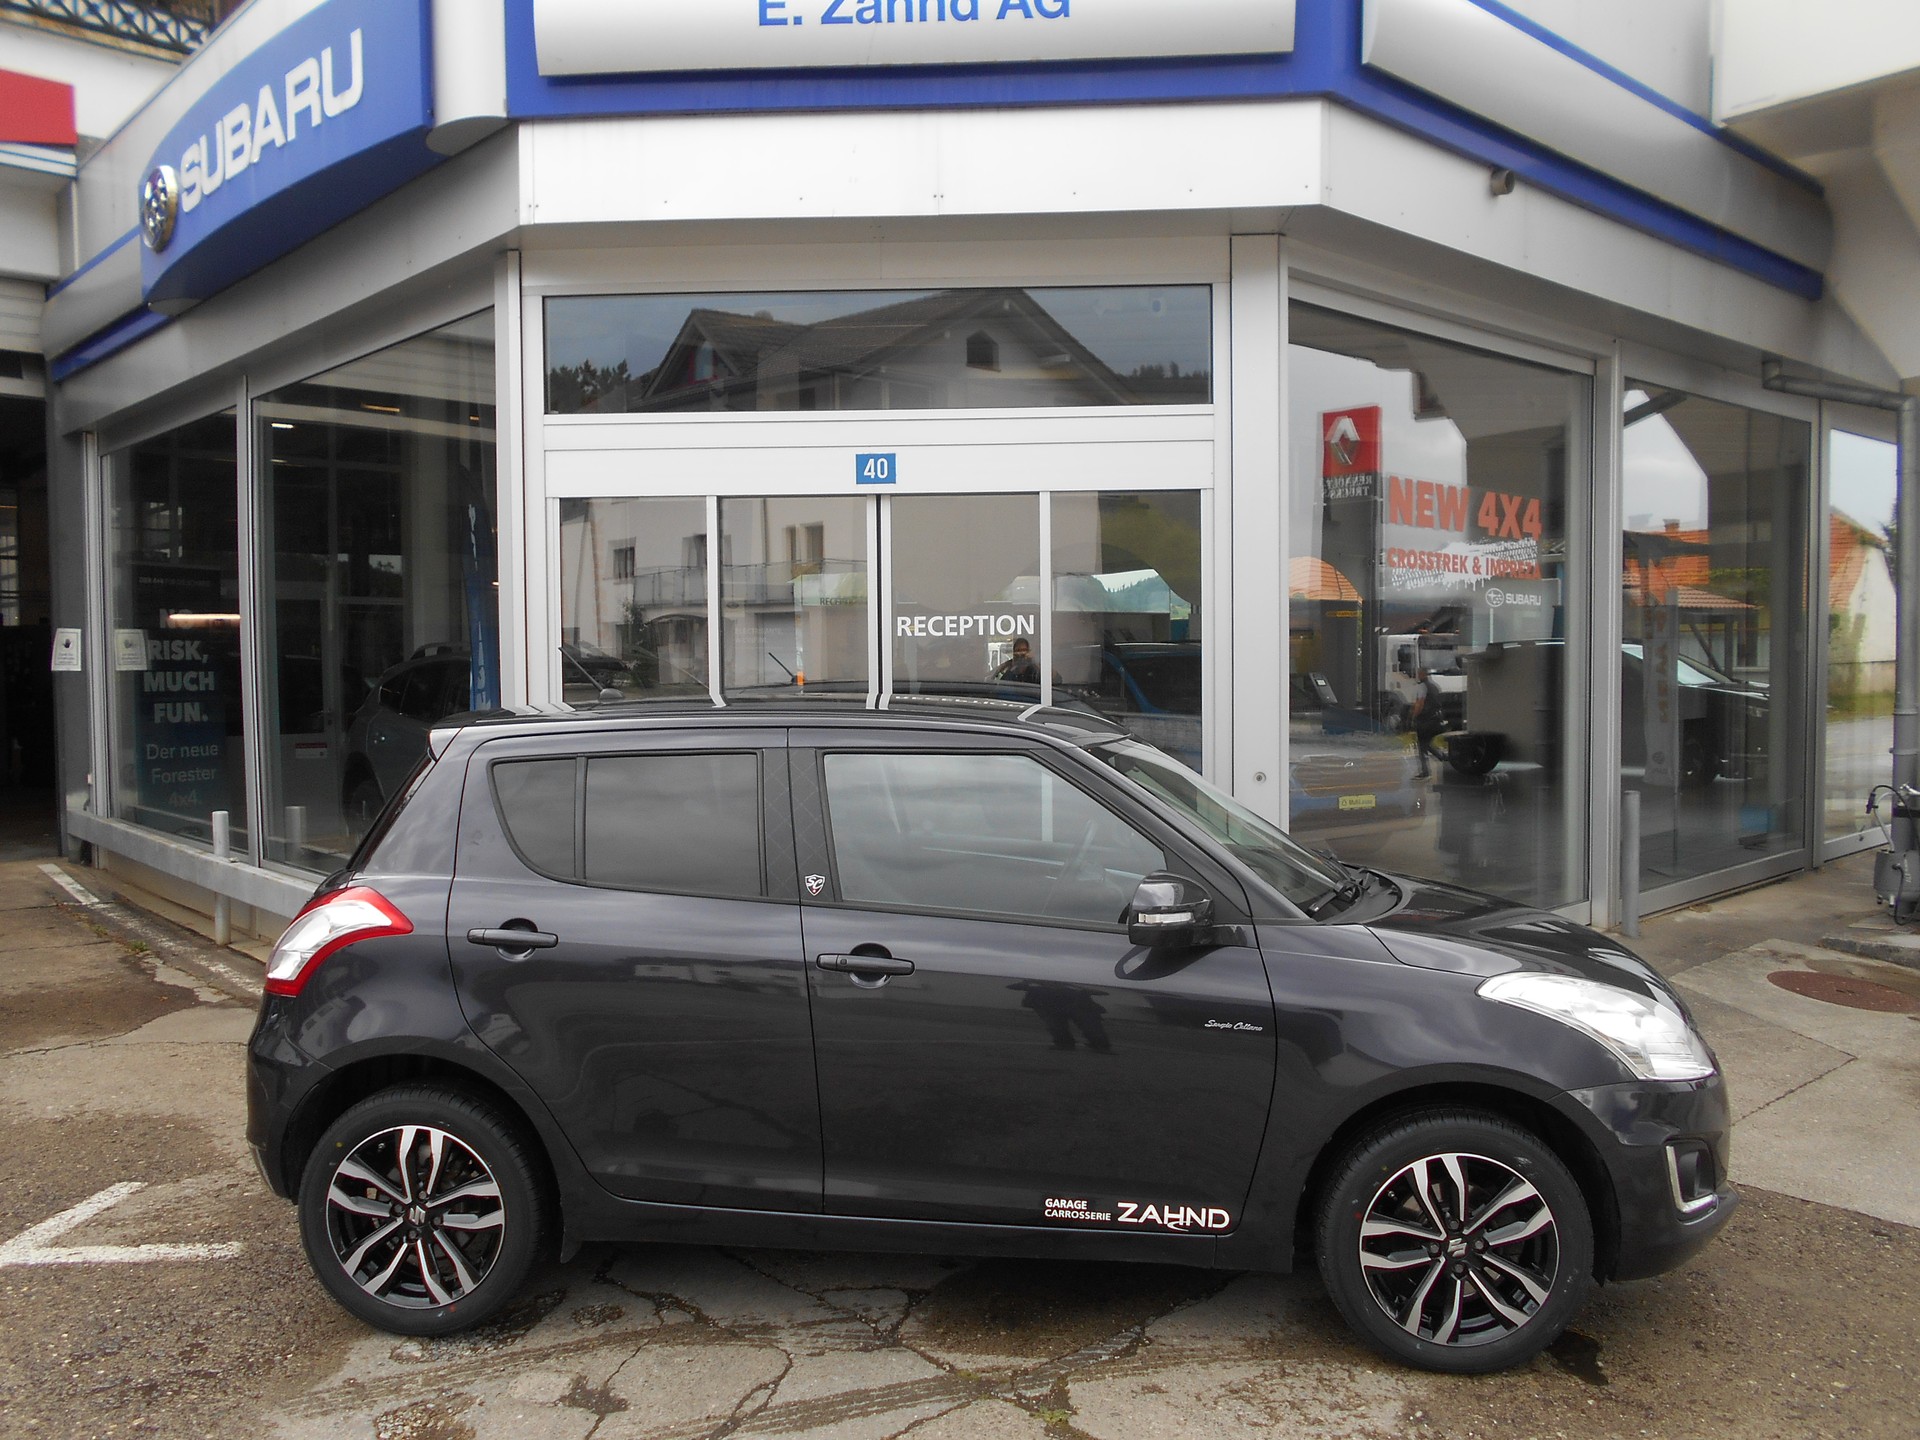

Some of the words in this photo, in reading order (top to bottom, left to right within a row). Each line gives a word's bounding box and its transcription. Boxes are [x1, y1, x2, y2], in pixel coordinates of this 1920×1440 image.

[758, 0, 803, 26] E.
[995, 0, 1071, 20] AG
[180, 27, 364, 213] SUBARU
[863, 457, 889, 479] 40
[1388, 475, 1472, 533] NEW
[1477, 490, 1544, 541] 4X4
[1386, 547, 1469, 575] CROSSTREK
[1472, 555, 1483, 576] &
[1485, 557, 1543, 581] IMPREZA
[1505, 593, 1543, 607] SUBARU
[896, 613, 1035, 637] RECEPTION
[149, 639, 209, 664] RISK,
[143, 670, 216, 693] MUCH
[153, 701, 209, 724] FUN.
[146, 743, 177, 760] Der
[180, 744, 219, 758] neue
[151, 767, 217, 785] Forester
[1044, 1198, 1088, 1210] GARAGE
[1044, 1208, 1112, 1222] CARROSSERIE
[1117, 1201, 1231, 1230] ZAHND
